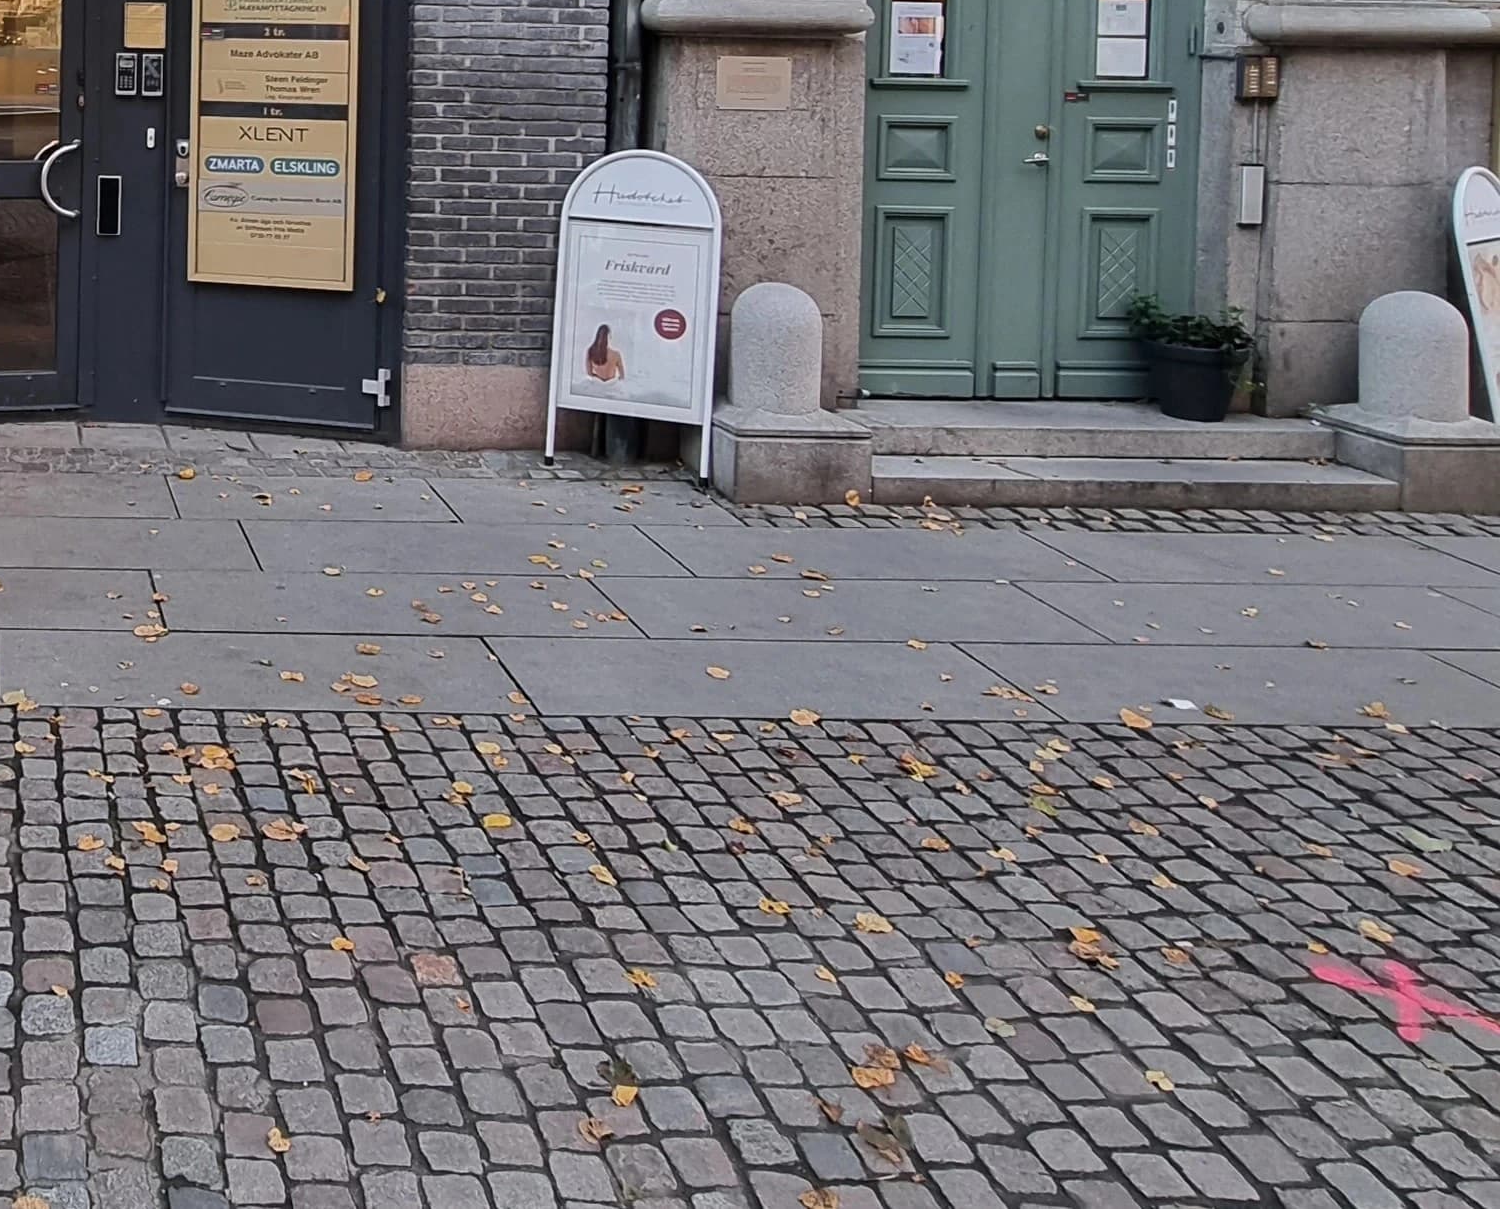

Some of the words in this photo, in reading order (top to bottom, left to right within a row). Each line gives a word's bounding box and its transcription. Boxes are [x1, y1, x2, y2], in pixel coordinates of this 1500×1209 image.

[305, 51, 319, 59] AB
[239, 126, 309, 142] XLENT
[209, 157, 261, 172] ZMARTA
[274, 160, 337, 175] ELSKLING
